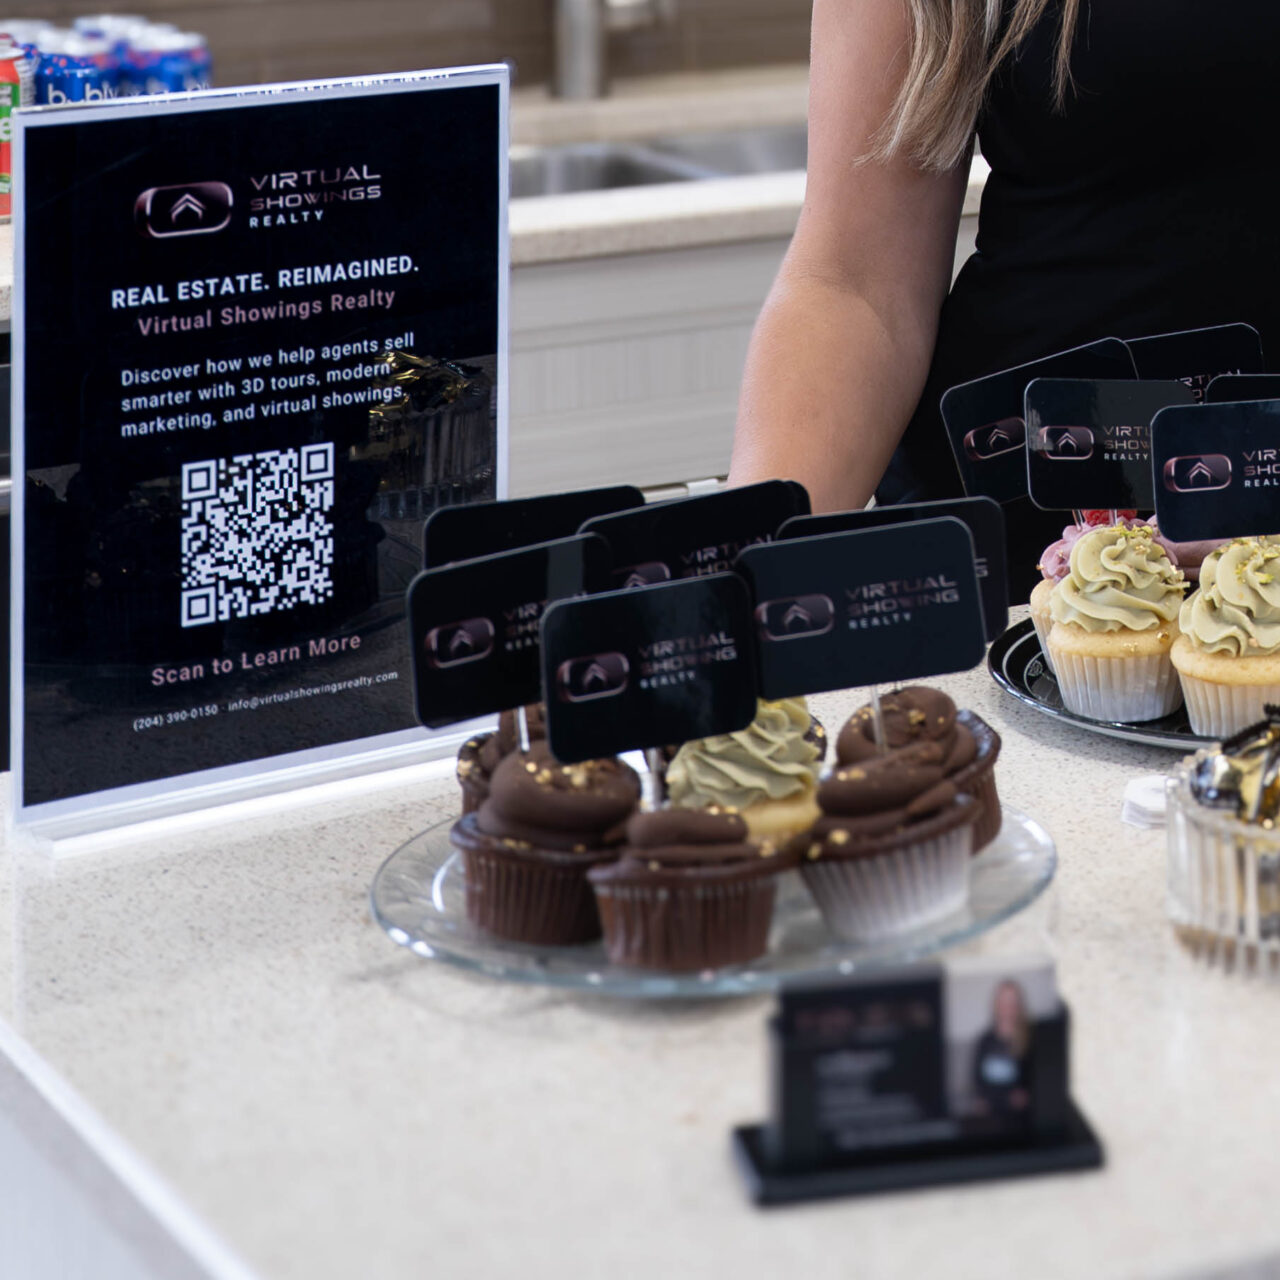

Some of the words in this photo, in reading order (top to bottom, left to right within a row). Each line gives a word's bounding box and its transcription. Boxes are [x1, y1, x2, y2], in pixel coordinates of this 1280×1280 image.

[250, 164, 381, 191] VIRTUAL
[250, 185, 381, 211] SHOWINGS
[249, 210, 323, 228] REALTY
[111, 284, 170, 309] REAL
[177, 273, 270, 300] ESTATE.
[278, 255, 419, 289] REIMAGINED.
[138, 309, 212, 336] Virtual
[220, 299, 322, 327] Showings
[331, 289, 396, 312] Realty
[121, 363, 200, 387] Discover
[206, 357, 242, 375] how
[248, 355, 272, 369] we
[278, 346, 315, 365] help
[321, 339, 379, 361] agents
[384, 331, 415, 351] sell
[121, 388, 192, 412] smarter
[198, 381, 235, 401] with
[241, 377, 264, 395] 3D
[271, 369, 320, 392] tours,
[326, 361, 390, 384] modern
[121, 410, 217, 438] marketing,
[223, 404, 256, 423] and
[261, 394, 317, 417] virtual
[322, 383, 407, 409] showings.
[1104, 453, 1149, 461] REALTY
[845, 574, 958, 600] VIRTUAL
[849, 612, 912, 630] REALTY
[151, 663, 204, 687] Scan
[212, 658, 234, 675] to
[241, 643, 301, 670] Learn
[309, 634, 362, 658] More
[639, 631, 735, 659] VIRTUAL
[133, 715, 164, 732] (204)
[166, 703, 219, 724] 390-0150
[228, 671, 399, 712] info@virtualshowingsrealty.com
